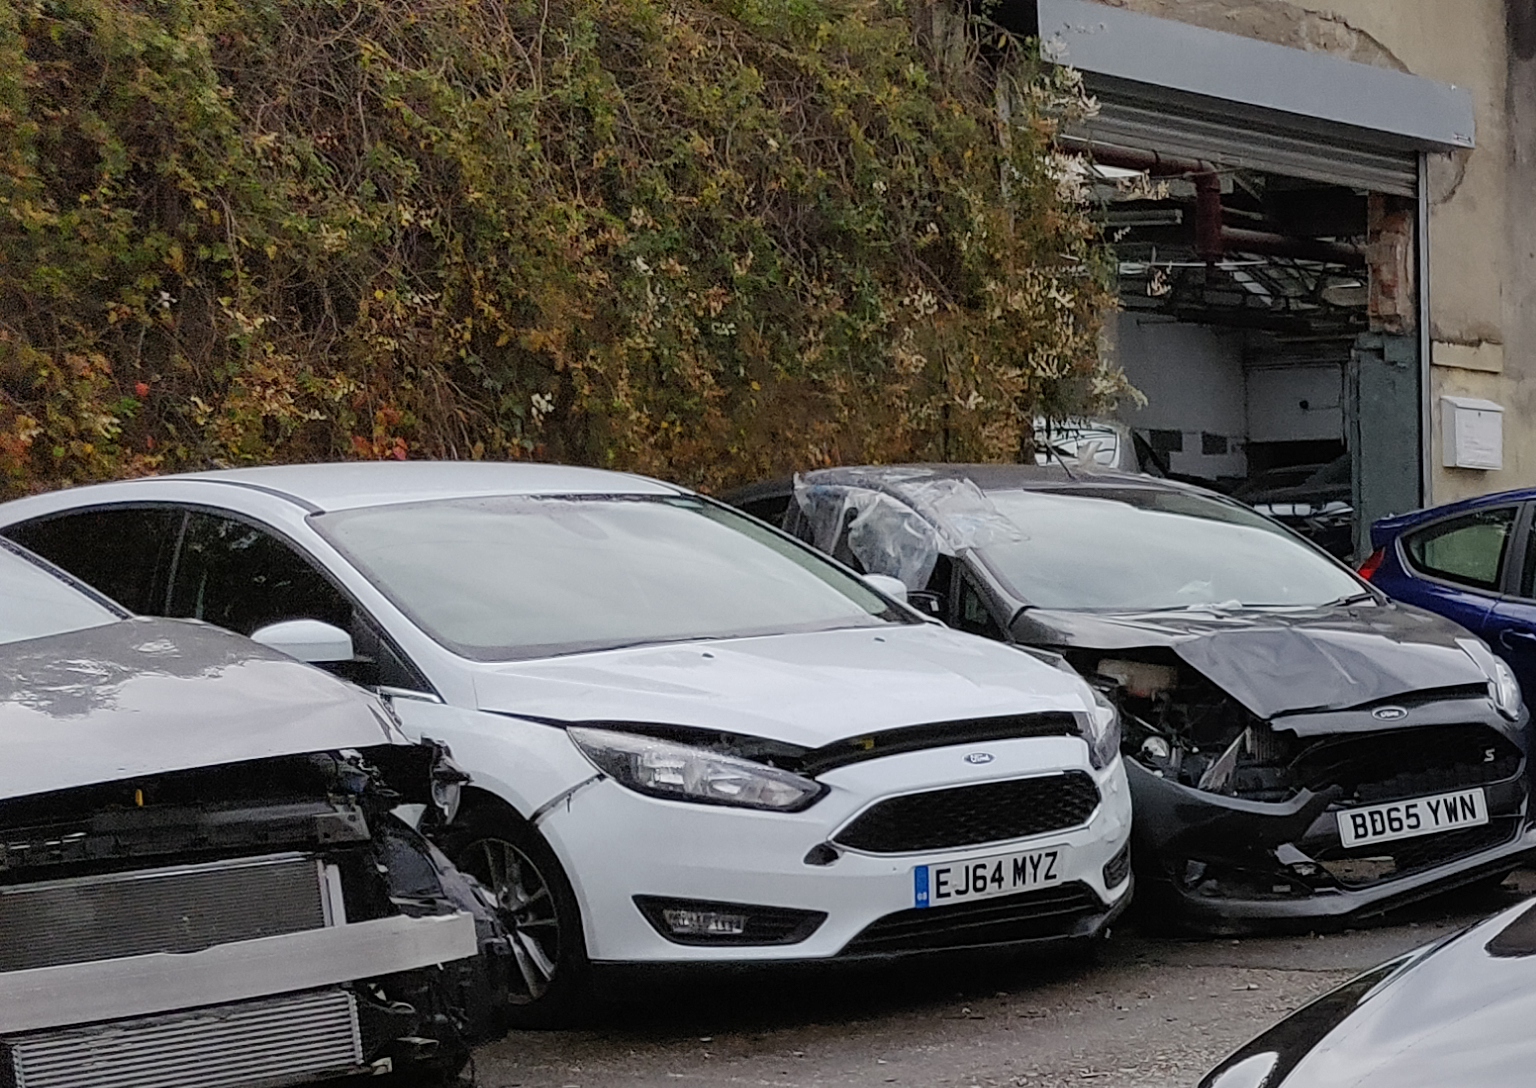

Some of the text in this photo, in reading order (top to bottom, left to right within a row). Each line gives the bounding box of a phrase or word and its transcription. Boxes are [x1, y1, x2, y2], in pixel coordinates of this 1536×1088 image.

[1349, 794, 1477, 840] BD65 YWN
[935, 850, 1058, 899] EJ64 MYZ
